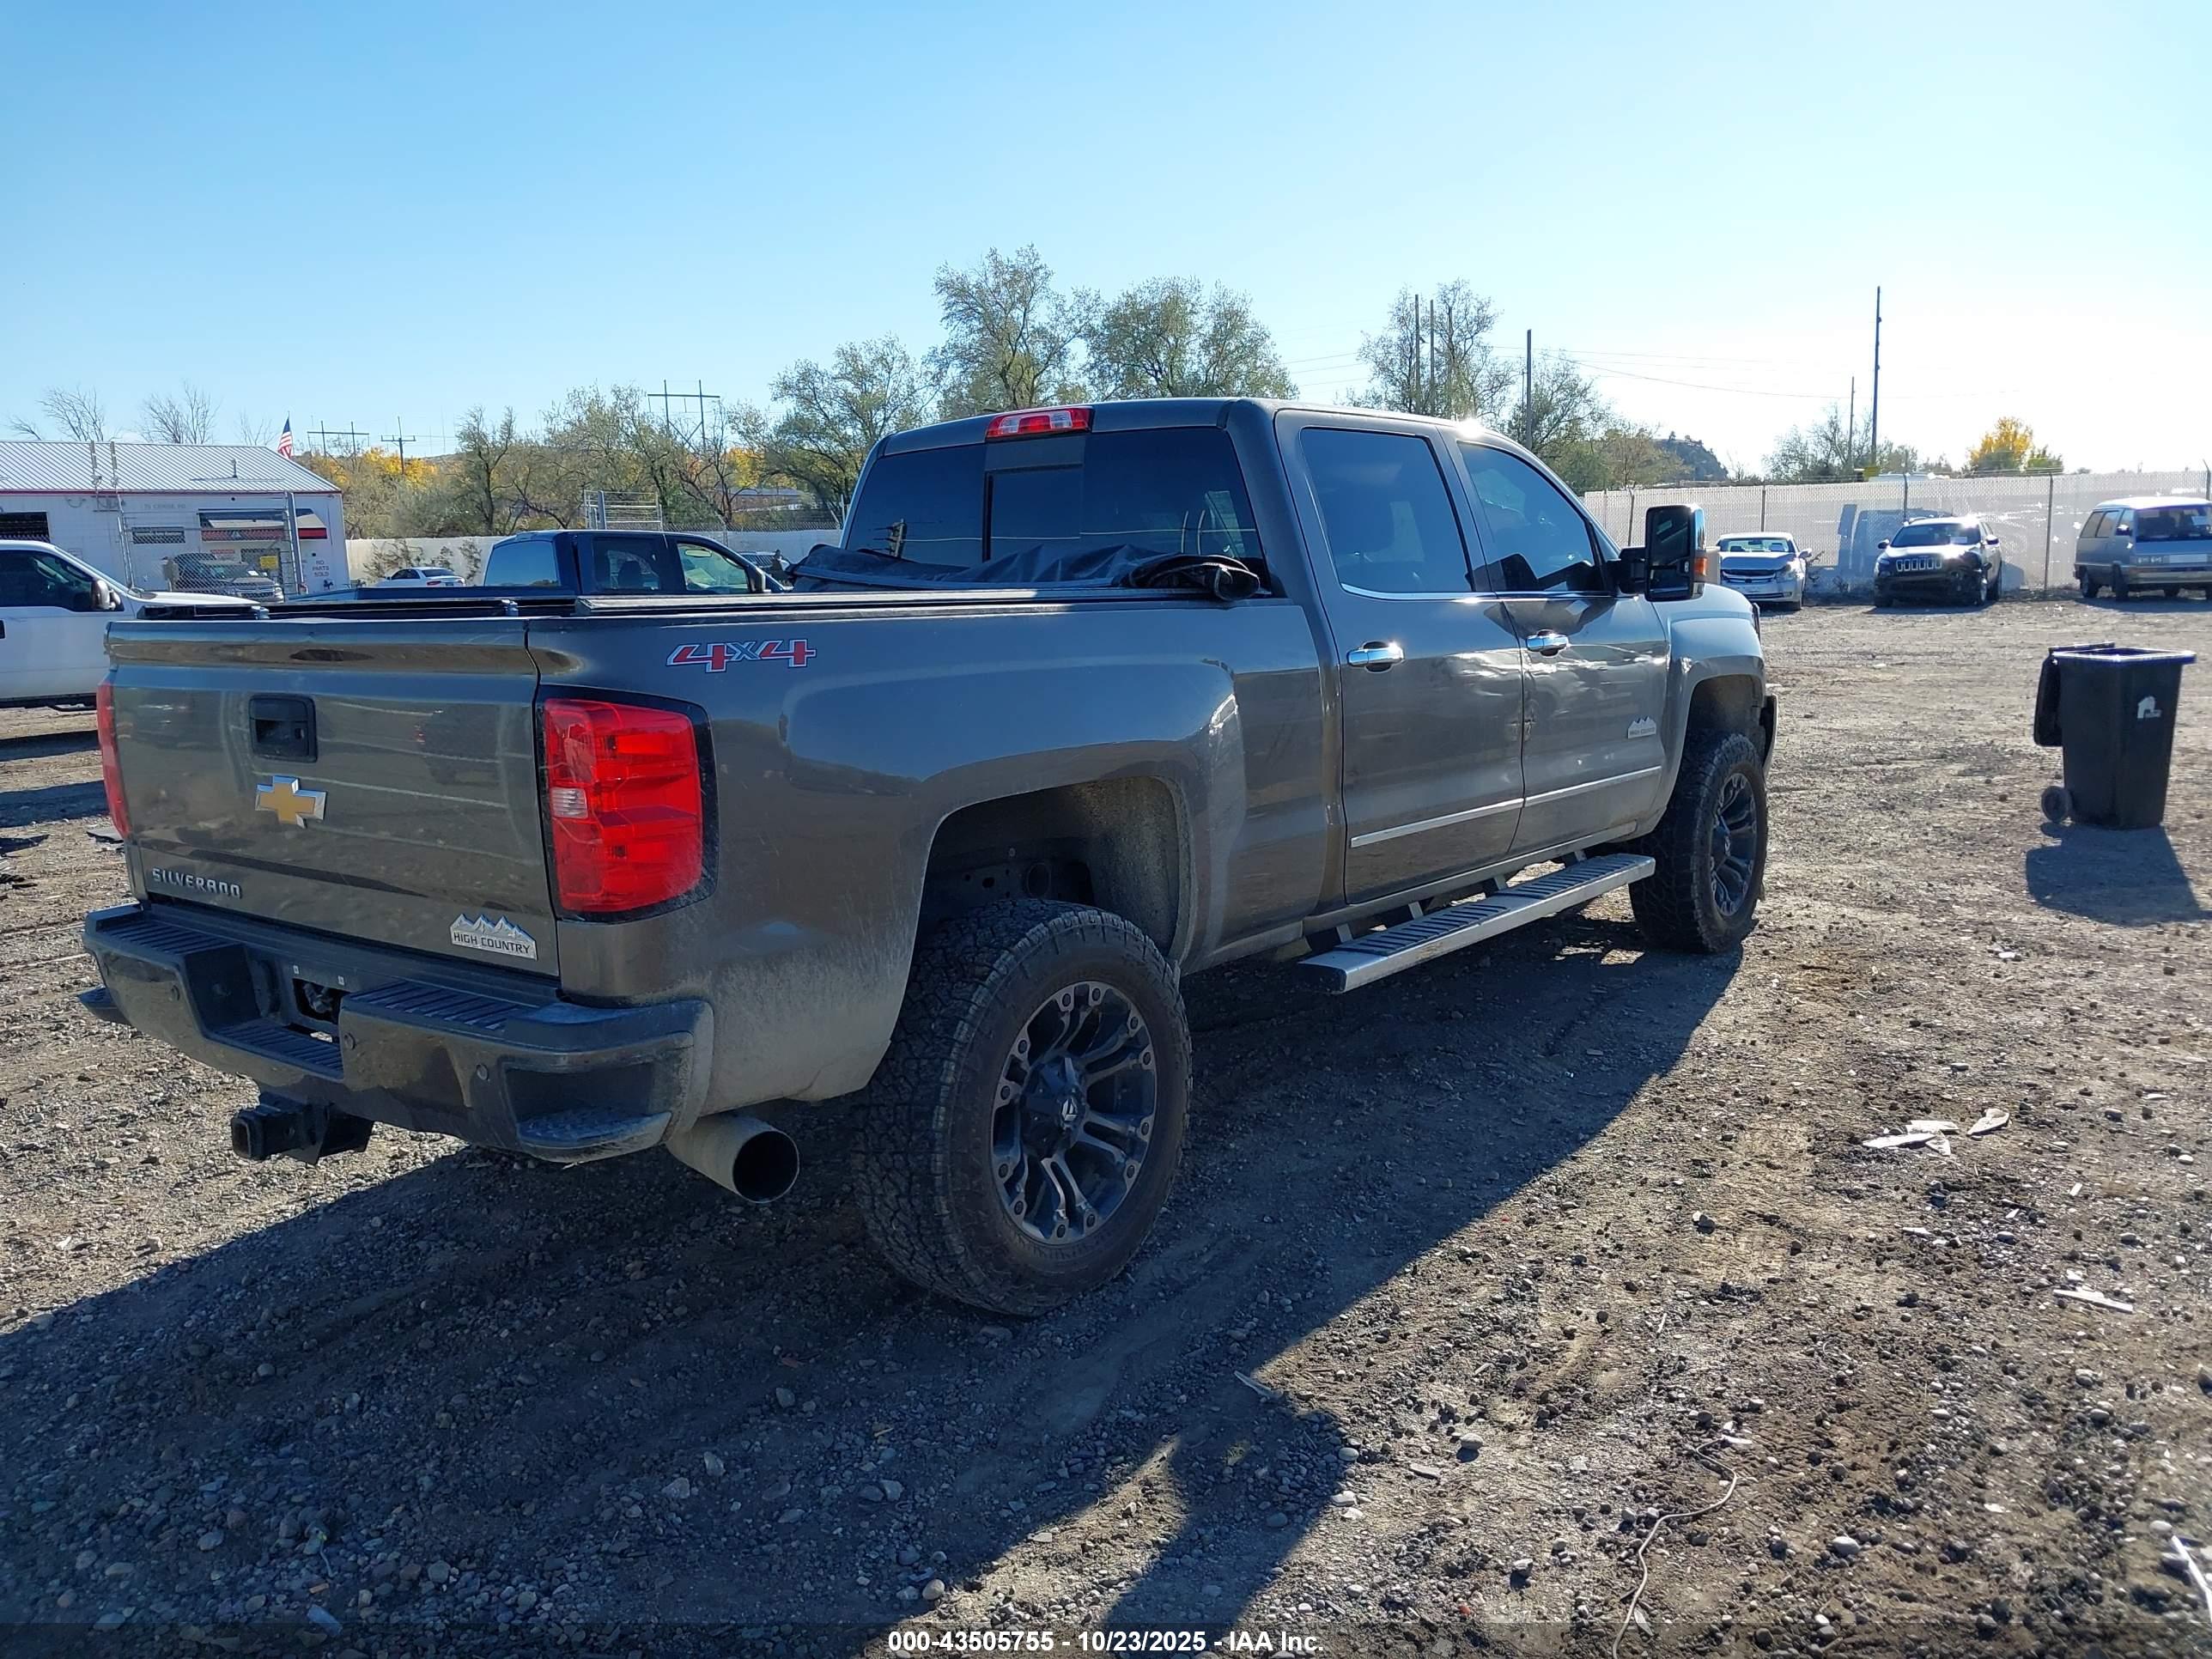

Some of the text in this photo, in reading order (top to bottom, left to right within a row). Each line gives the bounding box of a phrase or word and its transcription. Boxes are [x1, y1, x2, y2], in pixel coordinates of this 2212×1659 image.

[152, 867, 240, 899] SILVERADO
[453, 932, 531, 954] HIGH COUNTRY
